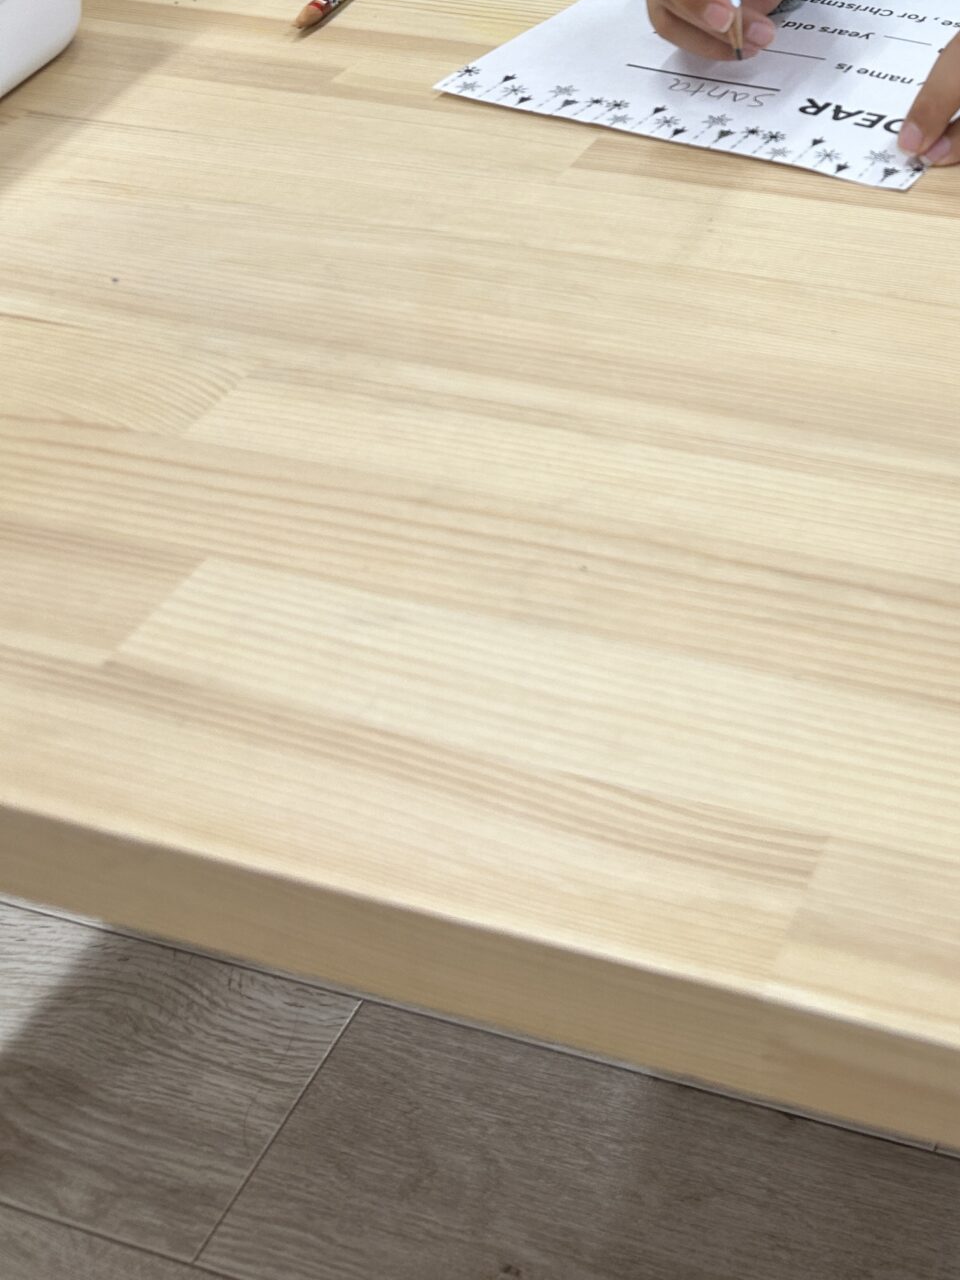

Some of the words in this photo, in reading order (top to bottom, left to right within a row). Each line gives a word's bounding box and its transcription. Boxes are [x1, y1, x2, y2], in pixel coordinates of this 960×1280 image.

[896, 12, 927, 23] for
[818, 26, 875, 40] years
[836, 62, 853, 73] is
[857, 68, 914, 86] name
